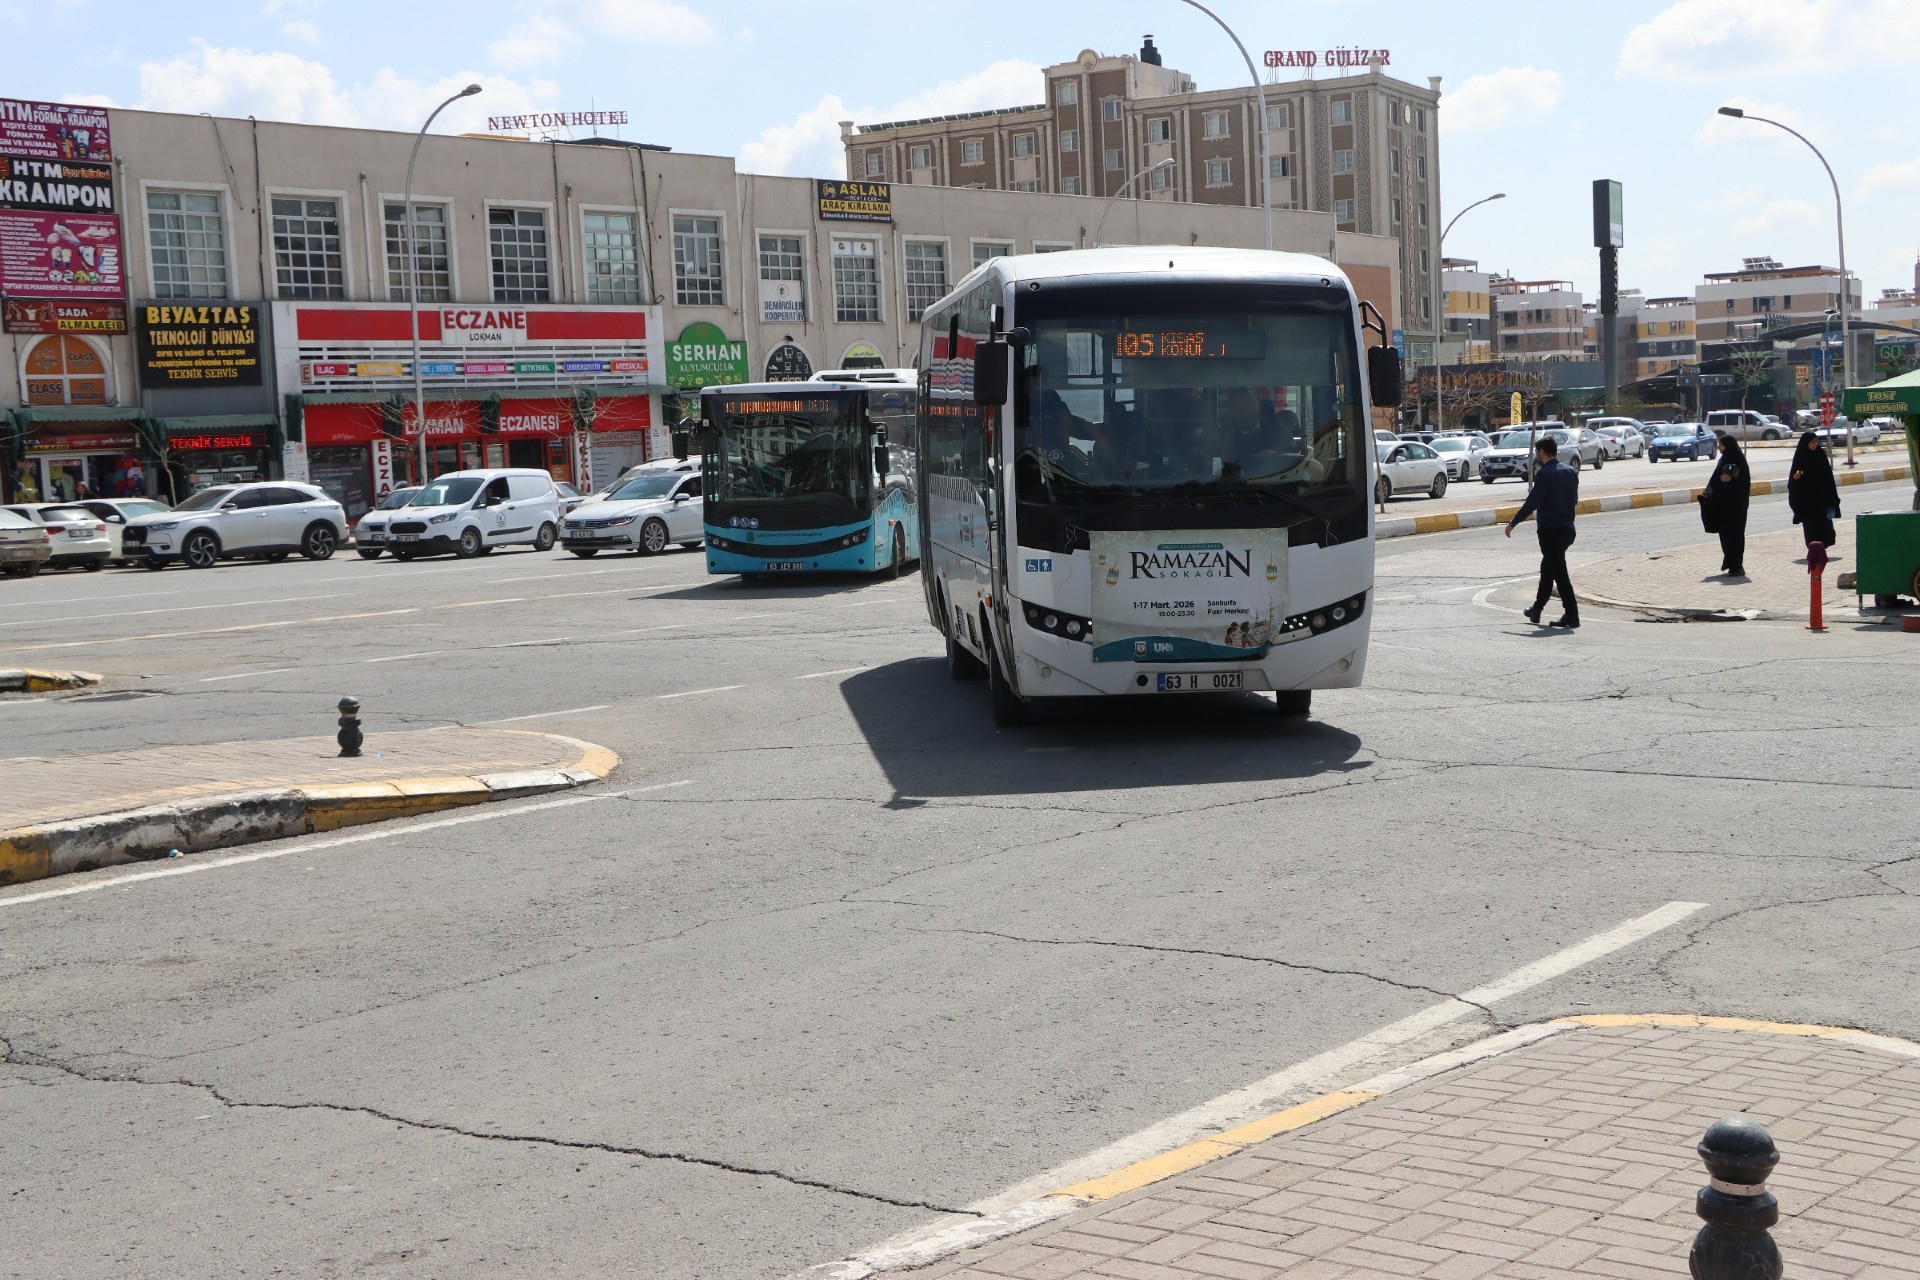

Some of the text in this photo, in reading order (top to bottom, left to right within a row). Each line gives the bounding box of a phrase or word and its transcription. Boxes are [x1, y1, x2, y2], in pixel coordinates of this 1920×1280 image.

[1264, 50, 1317, 67] GRAND
[33, 111, 63, 125] FORMA
[68, 114, 107, 128] KRAMPON
[488, 111, 628, 130] NEWTON HOTEL
[28, 122, 48, 131] ÖZEL
[24, 140, 57, 149] NUMARA
[29, 148, 58, 157] YAPILIR
[13, 161, 63, 179] HTM
[0, 179, 111, 209] KRAMPON
[839, 183, 887, 197] ASLAN
[823, 200, 846, 211] ARAÇ
[58, 308, 88, 317] SADA
[147, 306, 250, 330] BEYAZTAŞ
[60, 320, 123, 330] ALMALAEIB
[444, 311, 525, 330] ECZANE
[150, 327, 255, 346] TEKNOLOJİ DÜNYASI
[469, 333, 501, 341] LOKMAN
[1117, 332, 1154, 356] 105
[672, 344, 741, 361] SERHAN
[520, 363, 550, 372] BİTKİSEL
[680, 362, 735, 372] KUYUMCULUK
[168, 367, 238, 379] TEKNİK SERVİS
[29, 384, 62, 394] CLASS
[1867, 390, 1896, 401] TOST
[1128, 549, 1253, 580] RAMAZAN
[1160, 568, 1222, 579] SOKAĞI
[1133, 601, 1148, 609] 1-17
[1173, 600, 1195, 609] 2026
[1224, 607, 1251, 615] Merkezi
[1166, 675, 1181, 689] 63
[1190, 674, 1198, 688] H
[1213, 673, 1241, 688] 0021
